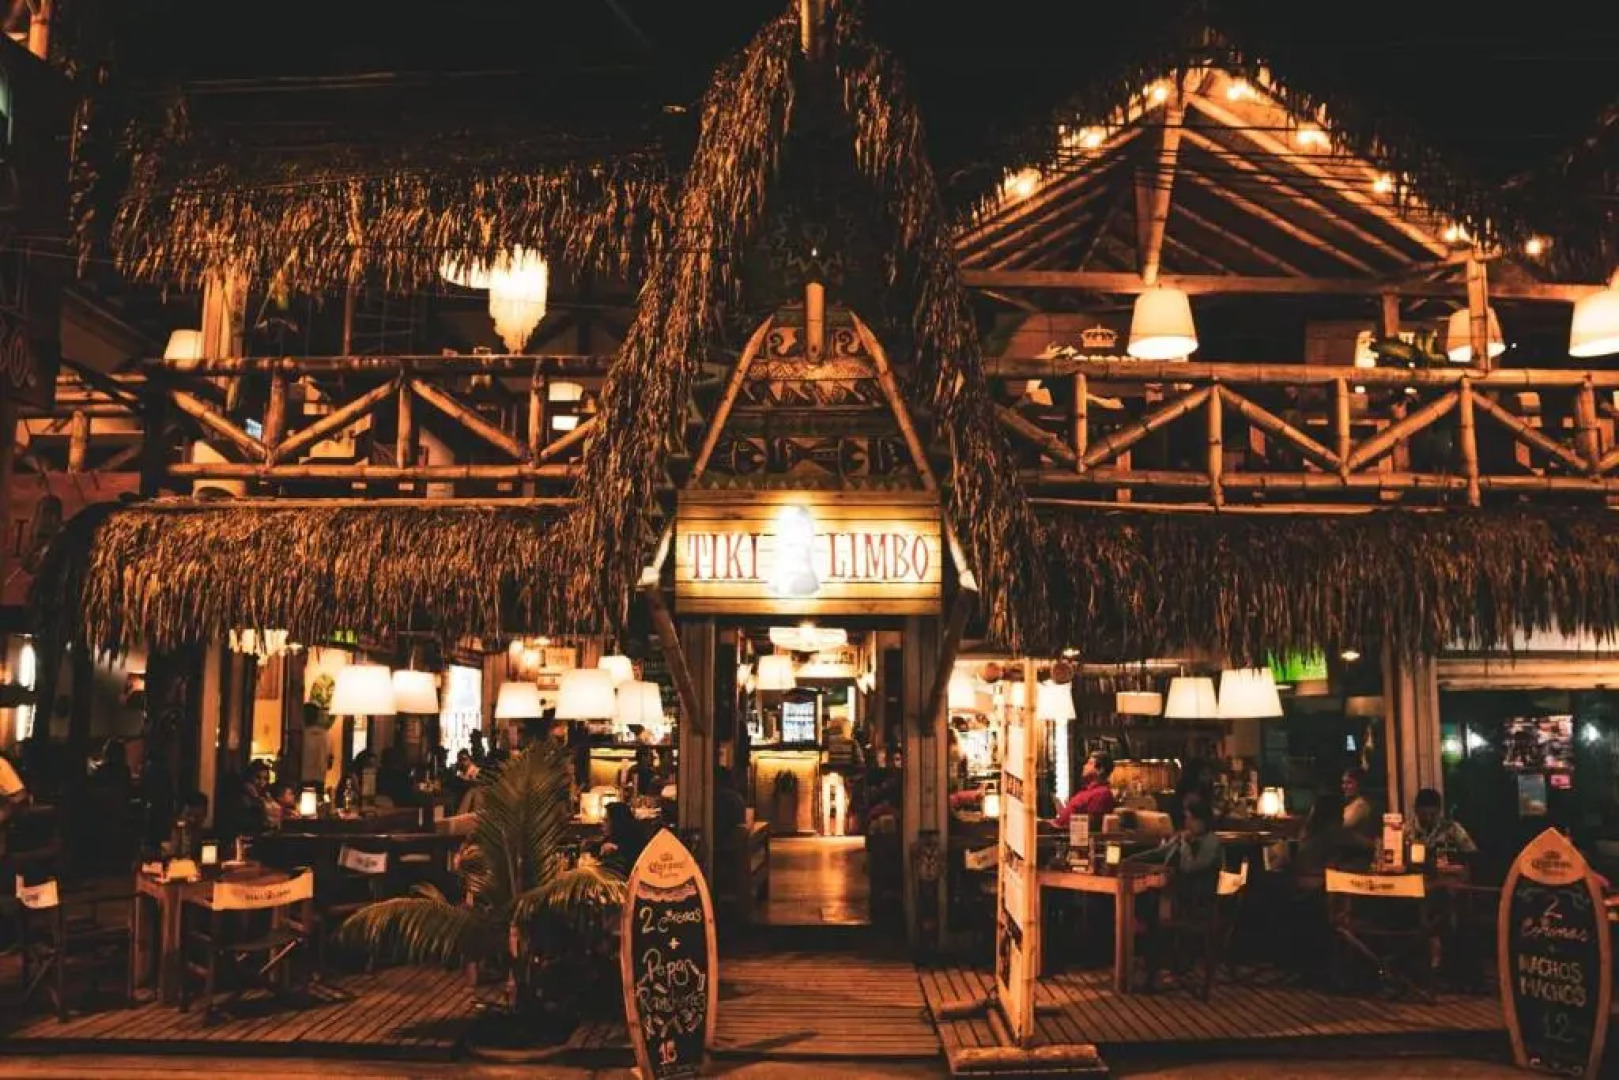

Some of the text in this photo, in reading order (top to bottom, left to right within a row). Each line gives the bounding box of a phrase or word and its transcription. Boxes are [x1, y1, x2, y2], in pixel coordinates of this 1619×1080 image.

[688, 532, 928, 580] TIKI LIMBO
[640, 907, 655, 933] 2
